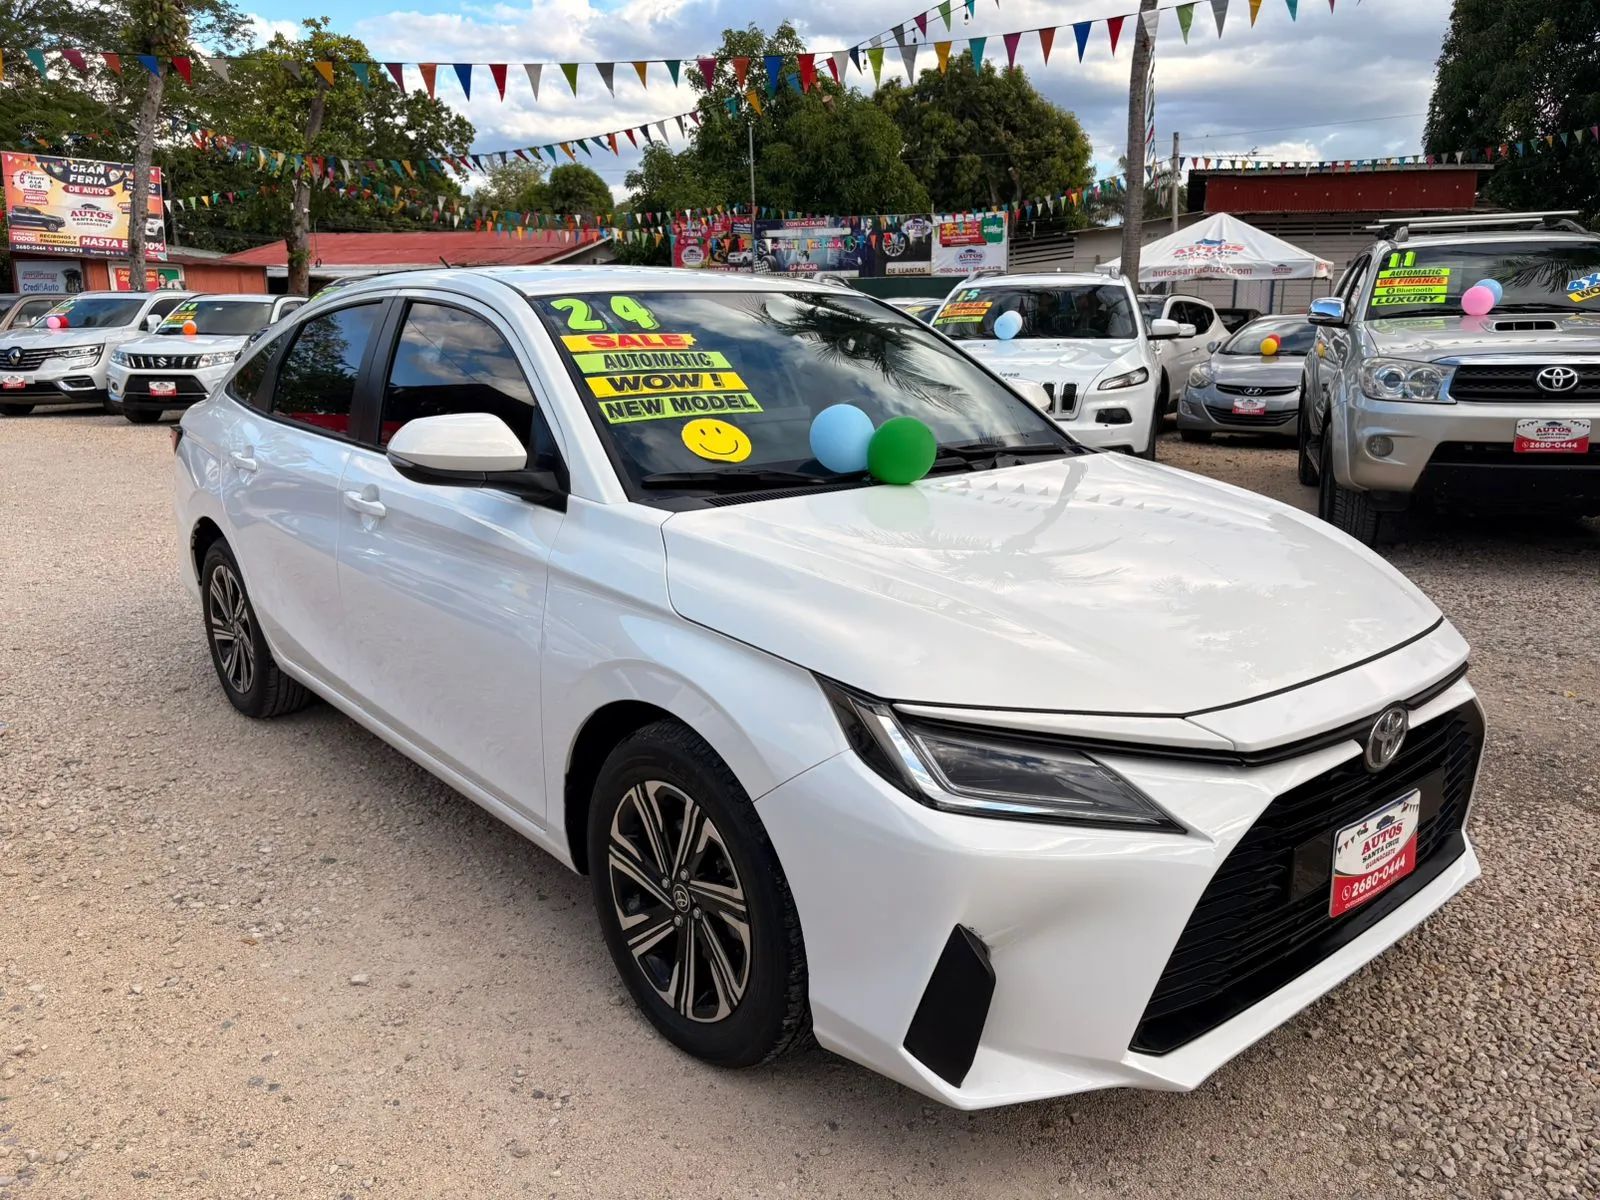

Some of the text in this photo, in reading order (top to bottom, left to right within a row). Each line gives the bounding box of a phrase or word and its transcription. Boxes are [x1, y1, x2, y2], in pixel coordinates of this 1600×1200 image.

[70, 164, 105, 175] GRAN
[69, 174, 107, 186] FERIA
[82, 187, 110, 195] AUTOS
[70, 210, 113, 220] AUTOS
[82, 237, 128, 249] HASTA E
[1388, 251, 1416, 268] 11
[1389, 269, 1442, 277] AUTOMATIC
[1376, 296, 1438, 304] LUXURY
[587, 334, 689, 349] SALE
[603, 351, 715, 370] AUTOMATIC
[605, 394, 757, 420] NEW MODEL
[1361, 822, 1403, 856] AUTOS
[1362, 837, 1400, 863] SANTA CRUZ
[1365, 848, 1396, 869] GUANACASTE
[1351, 853, 1406, 898] 2680-0444
